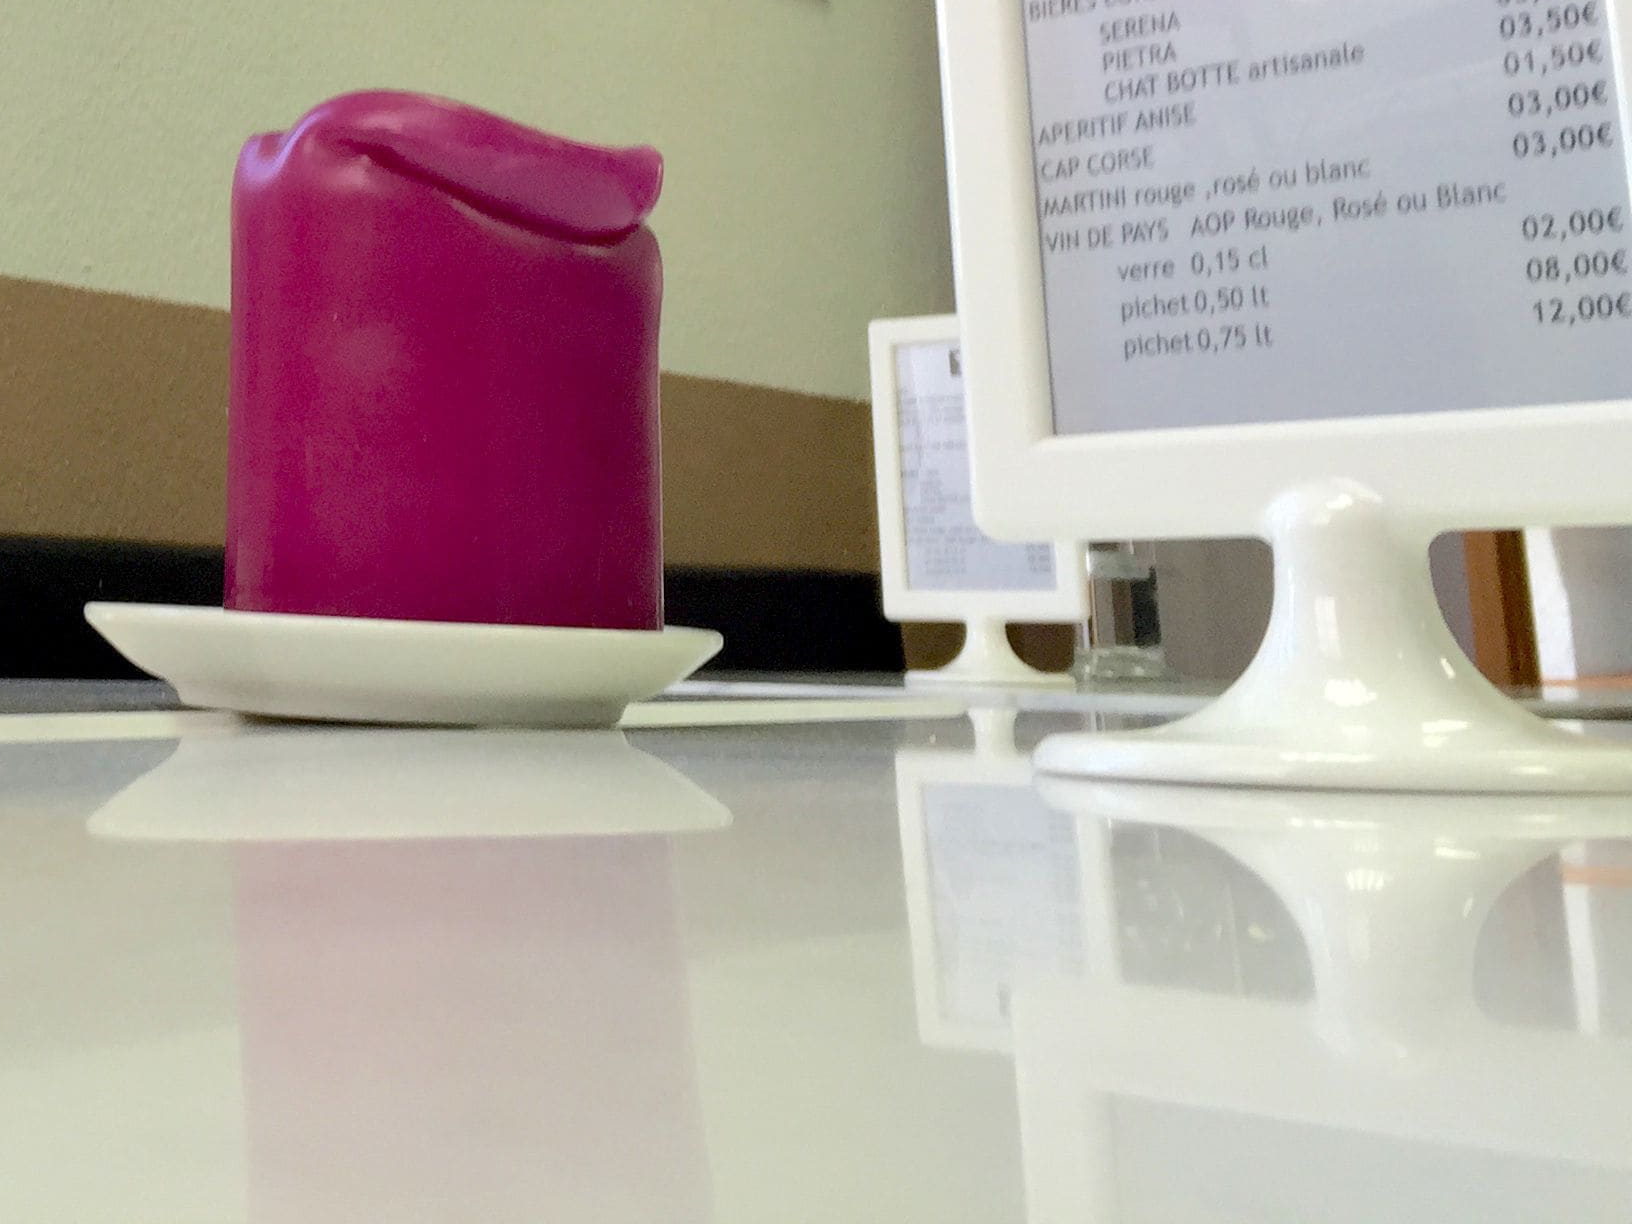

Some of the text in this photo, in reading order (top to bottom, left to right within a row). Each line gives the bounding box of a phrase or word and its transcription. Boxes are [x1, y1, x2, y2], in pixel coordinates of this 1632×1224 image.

[1100, 11, 1181, 46] SERENA
[1500, 0, 1598, 39] 03,50€
[1102, 41, 1176, 73] PIETRA
[1104, 42, 1364, 104] CHAT BOTTE artisanale
[1504, 38, 1603, 76] 01,50€
[1508, 80, 1608, 118] 03,00€
[1039, 100, 1196, 146] APERITIF ANISE
[1513, 121, 1613, 158] 03,00€
[1041, 144, 1154, 182] CAP CORSE
[1044, 186, 1126, 219] MARTINI
[1135, 181, 1195, 207] rouge
[1270, 169, 1297, 190] ou
[1305, 158, 1369, 184] blanc
[1046, 182, 1506, 252] VIN DE PAYS AOP Rouge, Rosé ou Blanc
[1522, 206, 1623, 242] 02,00€
[1118, 244, 1267, 281] verre 0,15 cl
[1526, 249, 1628, 285] 08,00€
[1121, 284, 1269, 325] pichet 0,50 lt
[1533, 292, 1632, 326] 12,00€
[1124, 323, 1273, 362] pichet 0,75 lt
